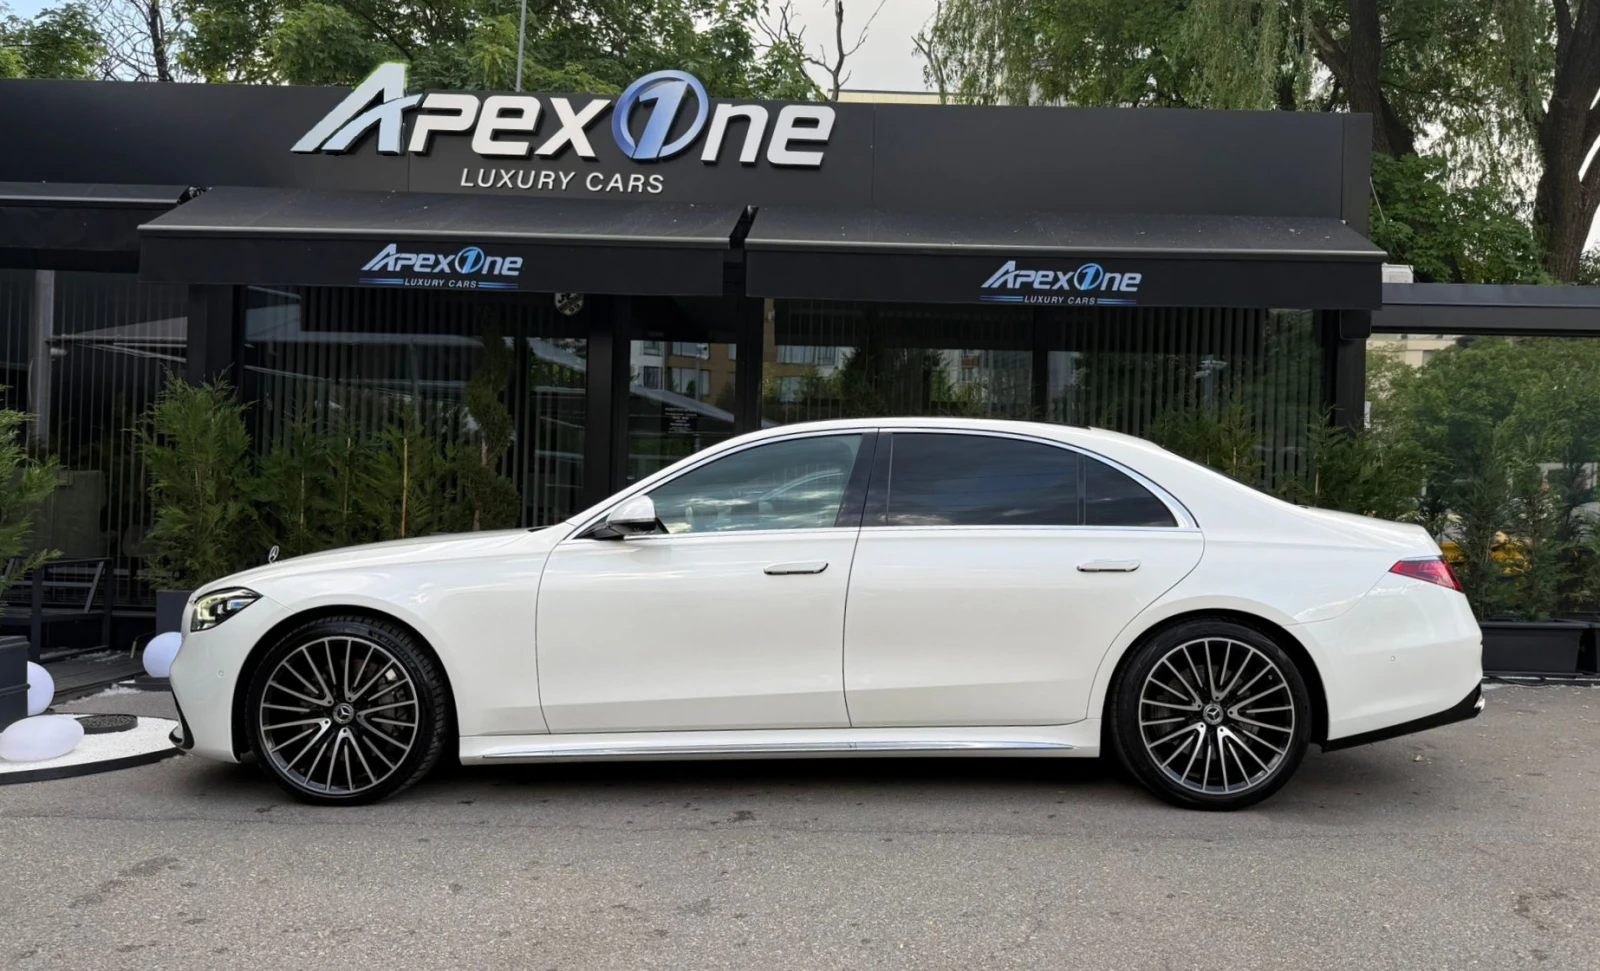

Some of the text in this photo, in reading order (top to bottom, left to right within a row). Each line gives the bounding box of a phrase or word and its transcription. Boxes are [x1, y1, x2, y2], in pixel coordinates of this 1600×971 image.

[460, 167, 665, 195] LUXURY CARS
[404, 278, 478, 289] LUXURY CARS
[1024, 295, 1096, 305] LUXURY CARS
